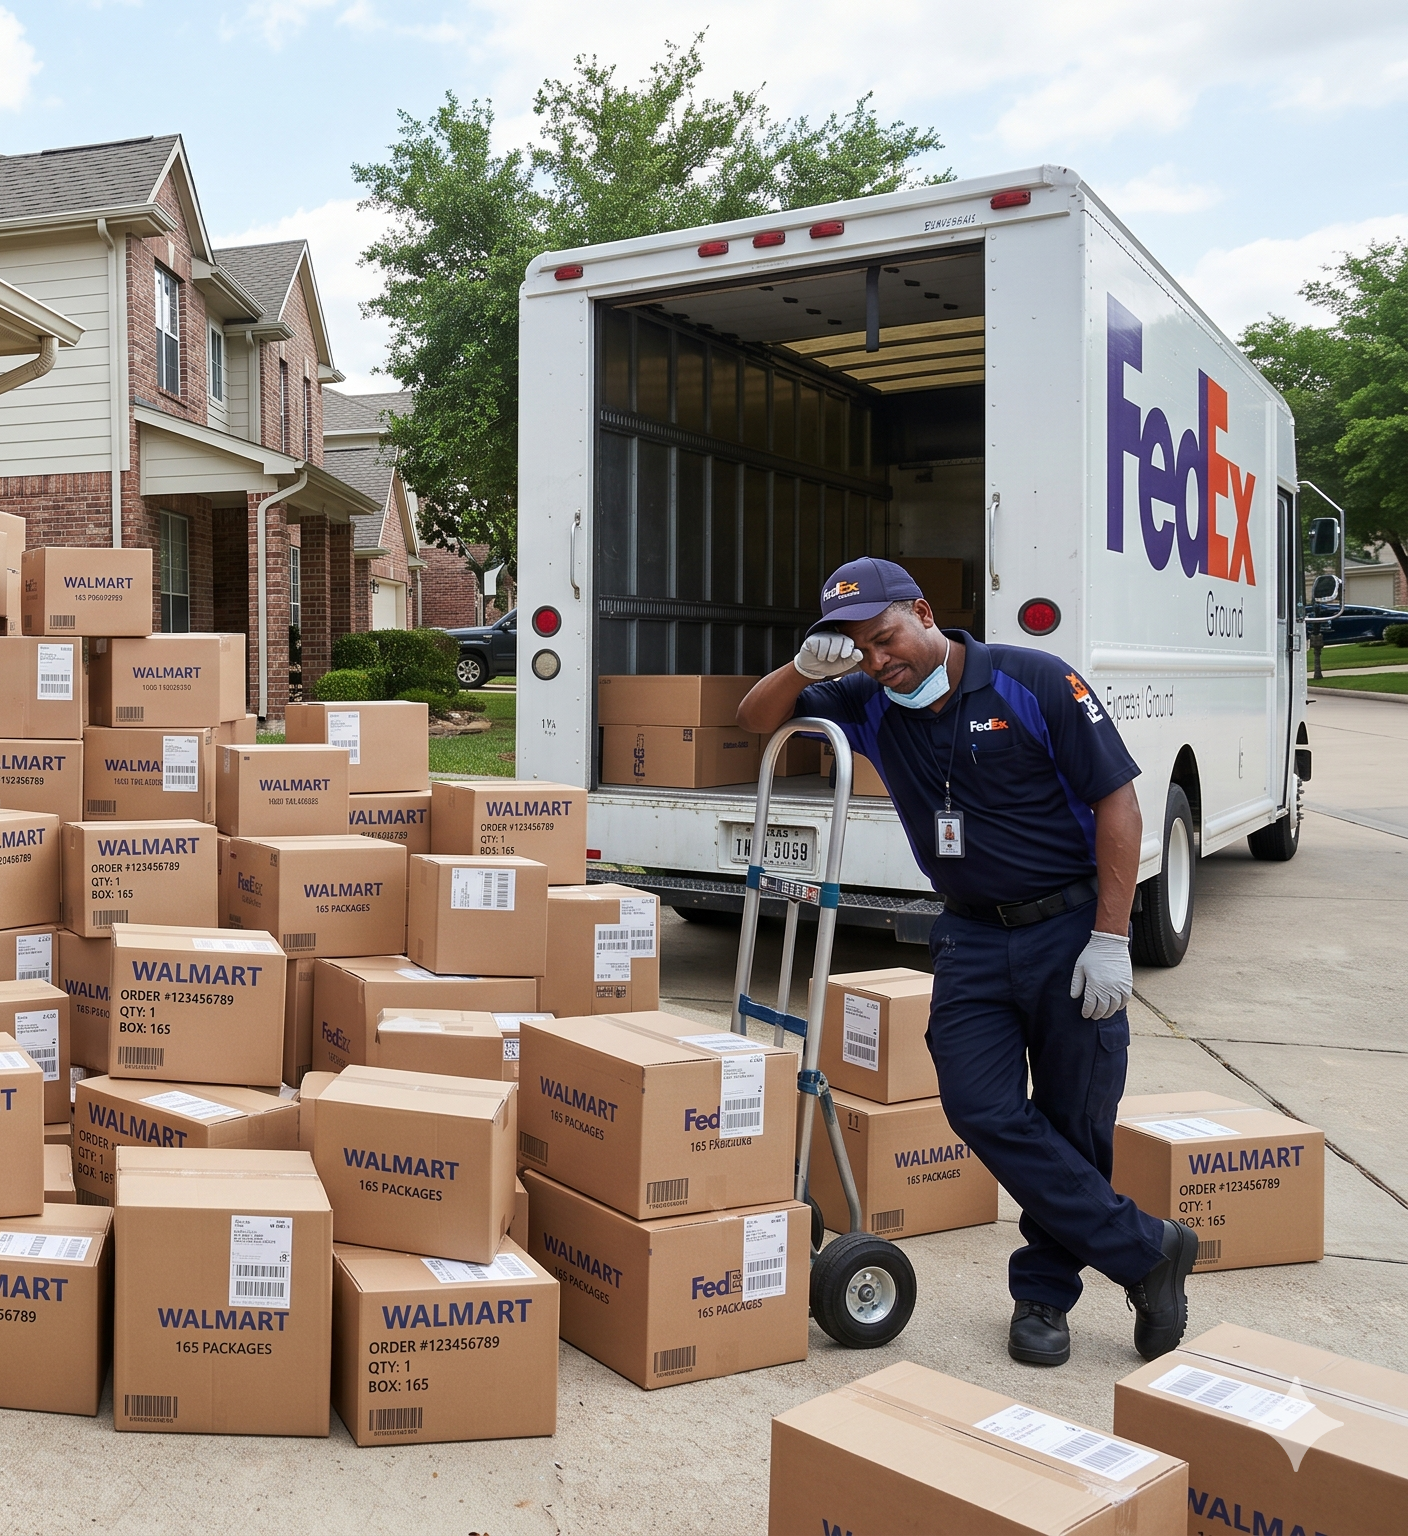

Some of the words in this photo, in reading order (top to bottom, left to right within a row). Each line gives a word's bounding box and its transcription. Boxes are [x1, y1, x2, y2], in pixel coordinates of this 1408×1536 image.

[1106, 291, 1256, 587] FedEx
[63, 576, 134, 589] WALMART
[1206, 591, 1244, 638] Ground
[132, 666, 202, 679] WALMART
[970, 718, 1009, 733] FedEx
[259, 778, 331, 792] WALMART
[485, 801, 572, 817] WALMART
[480, 823, 507, 832] ORDER
[97, 837, 200, 857] WALMART
[480, 835, 499, 844] QTY:
[501, 846, 515, 855] 165
[125, 861, 180, 872] #123456789
[91, 877, 113, 887] QTY:
[115, 877, 120, 886] 1
[91, 890, 114, 899] BOX:
[117, 889, 134, 898] 165
[304, 882, 383, 899] WALMART
[315, 904, 329, 913] 165
[331, 903, 371, 913] PACKAGES
[131, 961, 263, 986] WALMART
[120, 989, 161, 1003] ORDER
[164, 992, 234, 1006] #123456789
[120, 1006, 147, 1018] QTY:
[149, 1007, 156, 1018] 1
[119, 1021, 147, 1034] BOX:
[150, 1023, 171, 1035] 165
[539, 1075, 618, 1123] WALMART
[88, 1101, 188, 1148] WALMART
[565, 1113, 605, 1141] PACKAGES
[79, 1129, 109, 1150] ORDER
[690, 1139, 706, 1153] 165
[99, 1154, 104, 1165] 1
[894, 1142, 972, 1168] WALMART
[1188, 1145, 1305, 1175] WALMART
[343, 1147, 459, 1181] WALMART
[922, 1169, 961, 1184] PACKAGES
[381, 1181, 443, 1202] PACKAGES
[1179, 1183, 1216, 1196] ORDER
[1218, 1178, 1280, 1193] #123456789
[1179, 1201, 1204, 1213] QTY:
[1207, 1200, 1212, 1211] 1
[1207, 1215, 1226, 1226] 165
[543, 1232, 623, 1289] WALMART
[569, 1270, 610, 1305] PACKAGES
[157, 1307, 290, 1332] WALMART
[382, 1299, 533, 1329] WALMART
[176, 1341, 199, 1354] 165
[202, 1341, 273, 1356] PACKAGES
[369, 1339, 417, 1355] ORDER
[420, 1335, 500, 1353] #123456789
[368, 1360, 400, 1375] QTY:
[404, 1360, 411, 1373] 1
[368, 1378, 402, 1394] BOX:
[405, 1377, 429, 1392] 165
